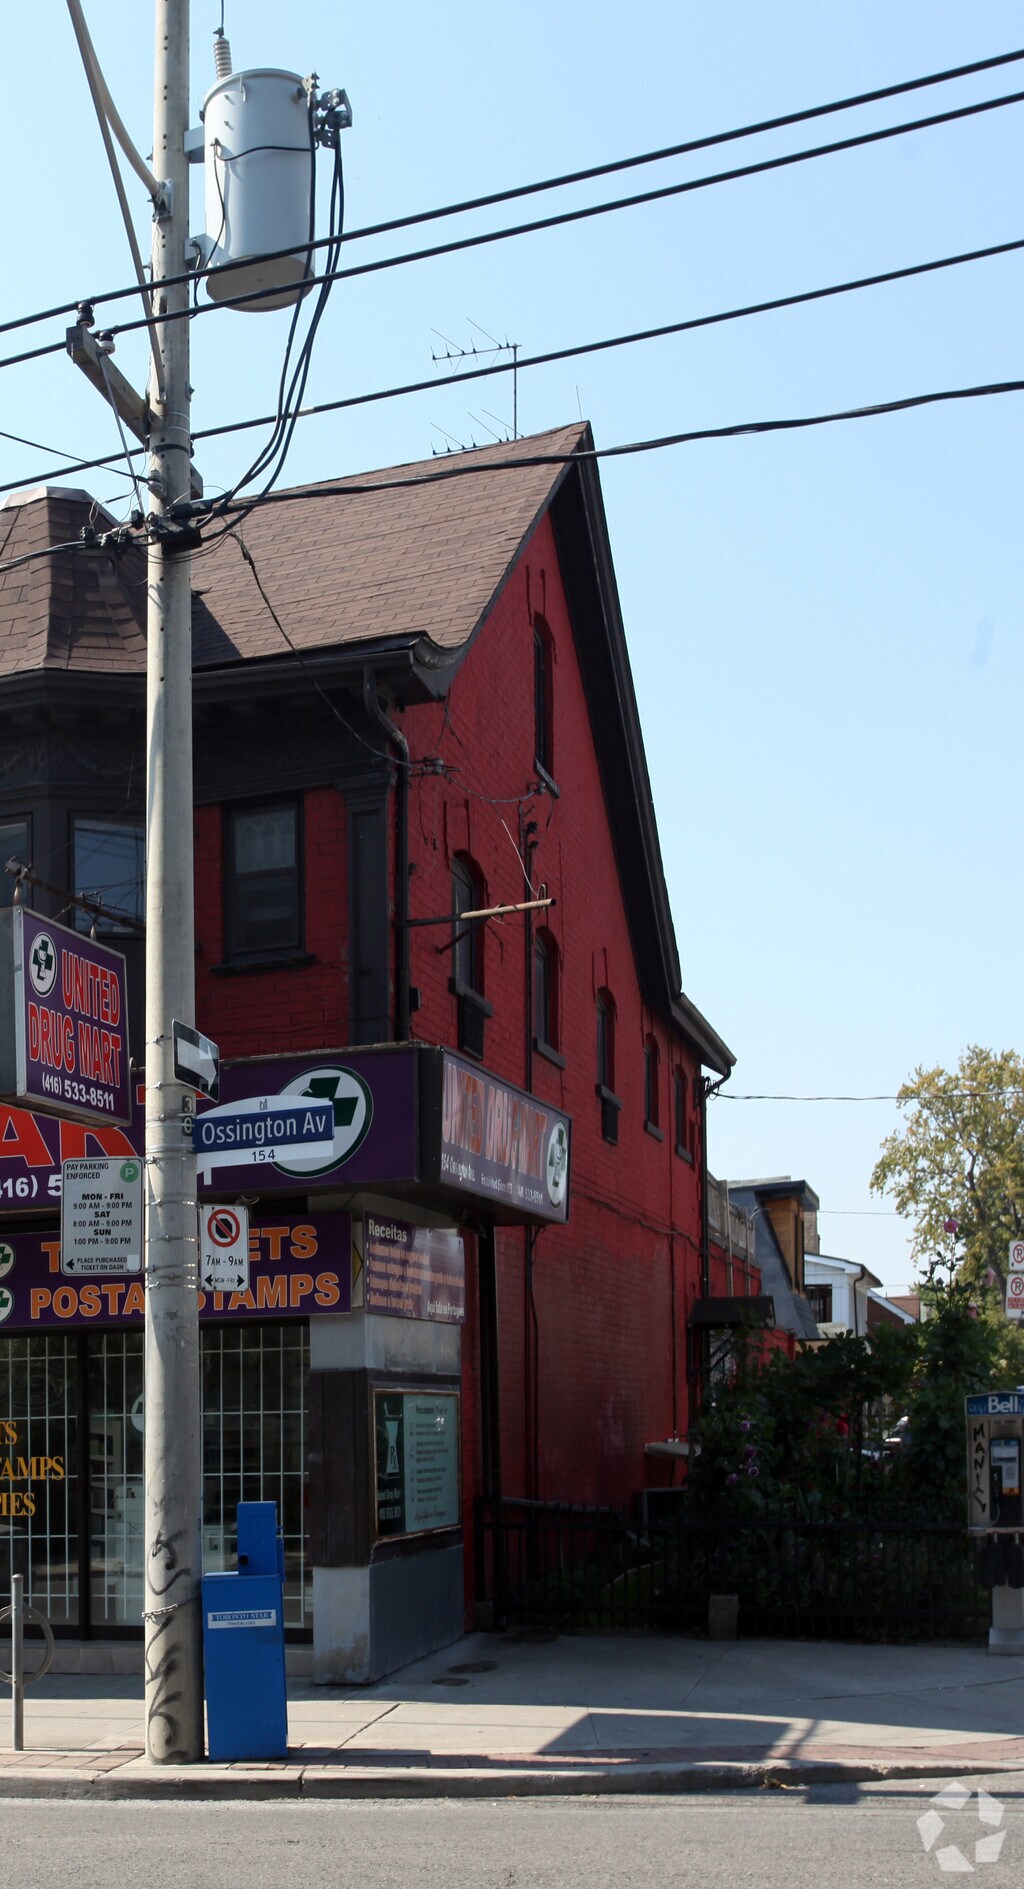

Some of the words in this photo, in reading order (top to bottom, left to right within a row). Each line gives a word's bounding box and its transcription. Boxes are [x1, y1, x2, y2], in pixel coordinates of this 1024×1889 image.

[62, 949, 120, 1027] UNITED
[28, 1001, 75, 1073] DRUG
[78, 1020, 121, 1088] MART
[42, 1072, 62, 1095] (416)
[64, 1080, 114, 1111] 533-8511
[201, 1116, 297, 1145] Ossington
[302, 1111, 326, 1135] Av
[80, 1162, 109, 1170] PARKING
[251, 1149, 276, 1162] 154
[66, 1172, 100, 1180] ENFORCED
[368, 1218, 408, 1242] Receitas
[206, 1255, 220, 1266] 7AM
[228, 1255, 243, 1266] 9AM
[30, 1282, 145, 1319] POSTA
[988, 1395, 1018, 1413] Bell
[216, 1613, 249, 1621] TORONTO
